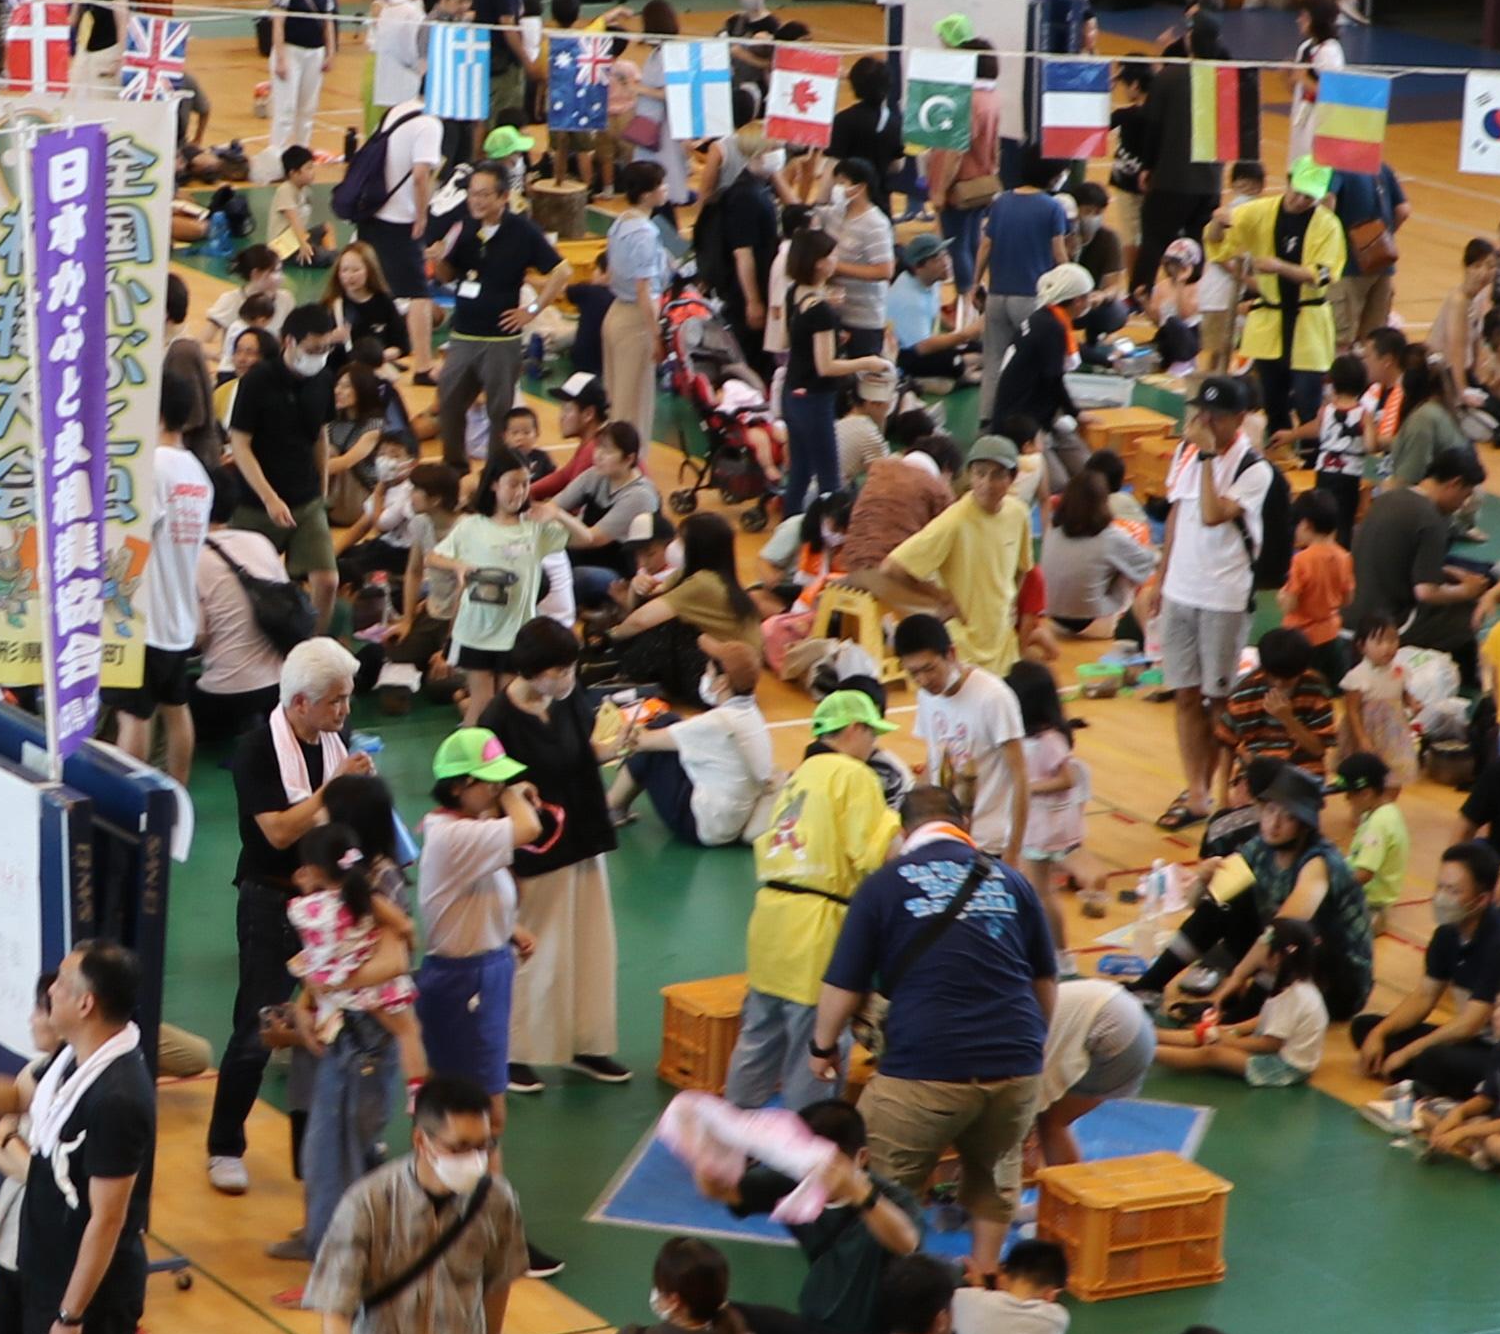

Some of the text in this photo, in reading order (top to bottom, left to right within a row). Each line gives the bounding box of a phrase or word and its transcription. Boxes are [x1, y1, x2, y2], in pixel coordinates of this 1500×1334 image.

[46, 146, 104, 691] 日本かぶと虫相撲協会
